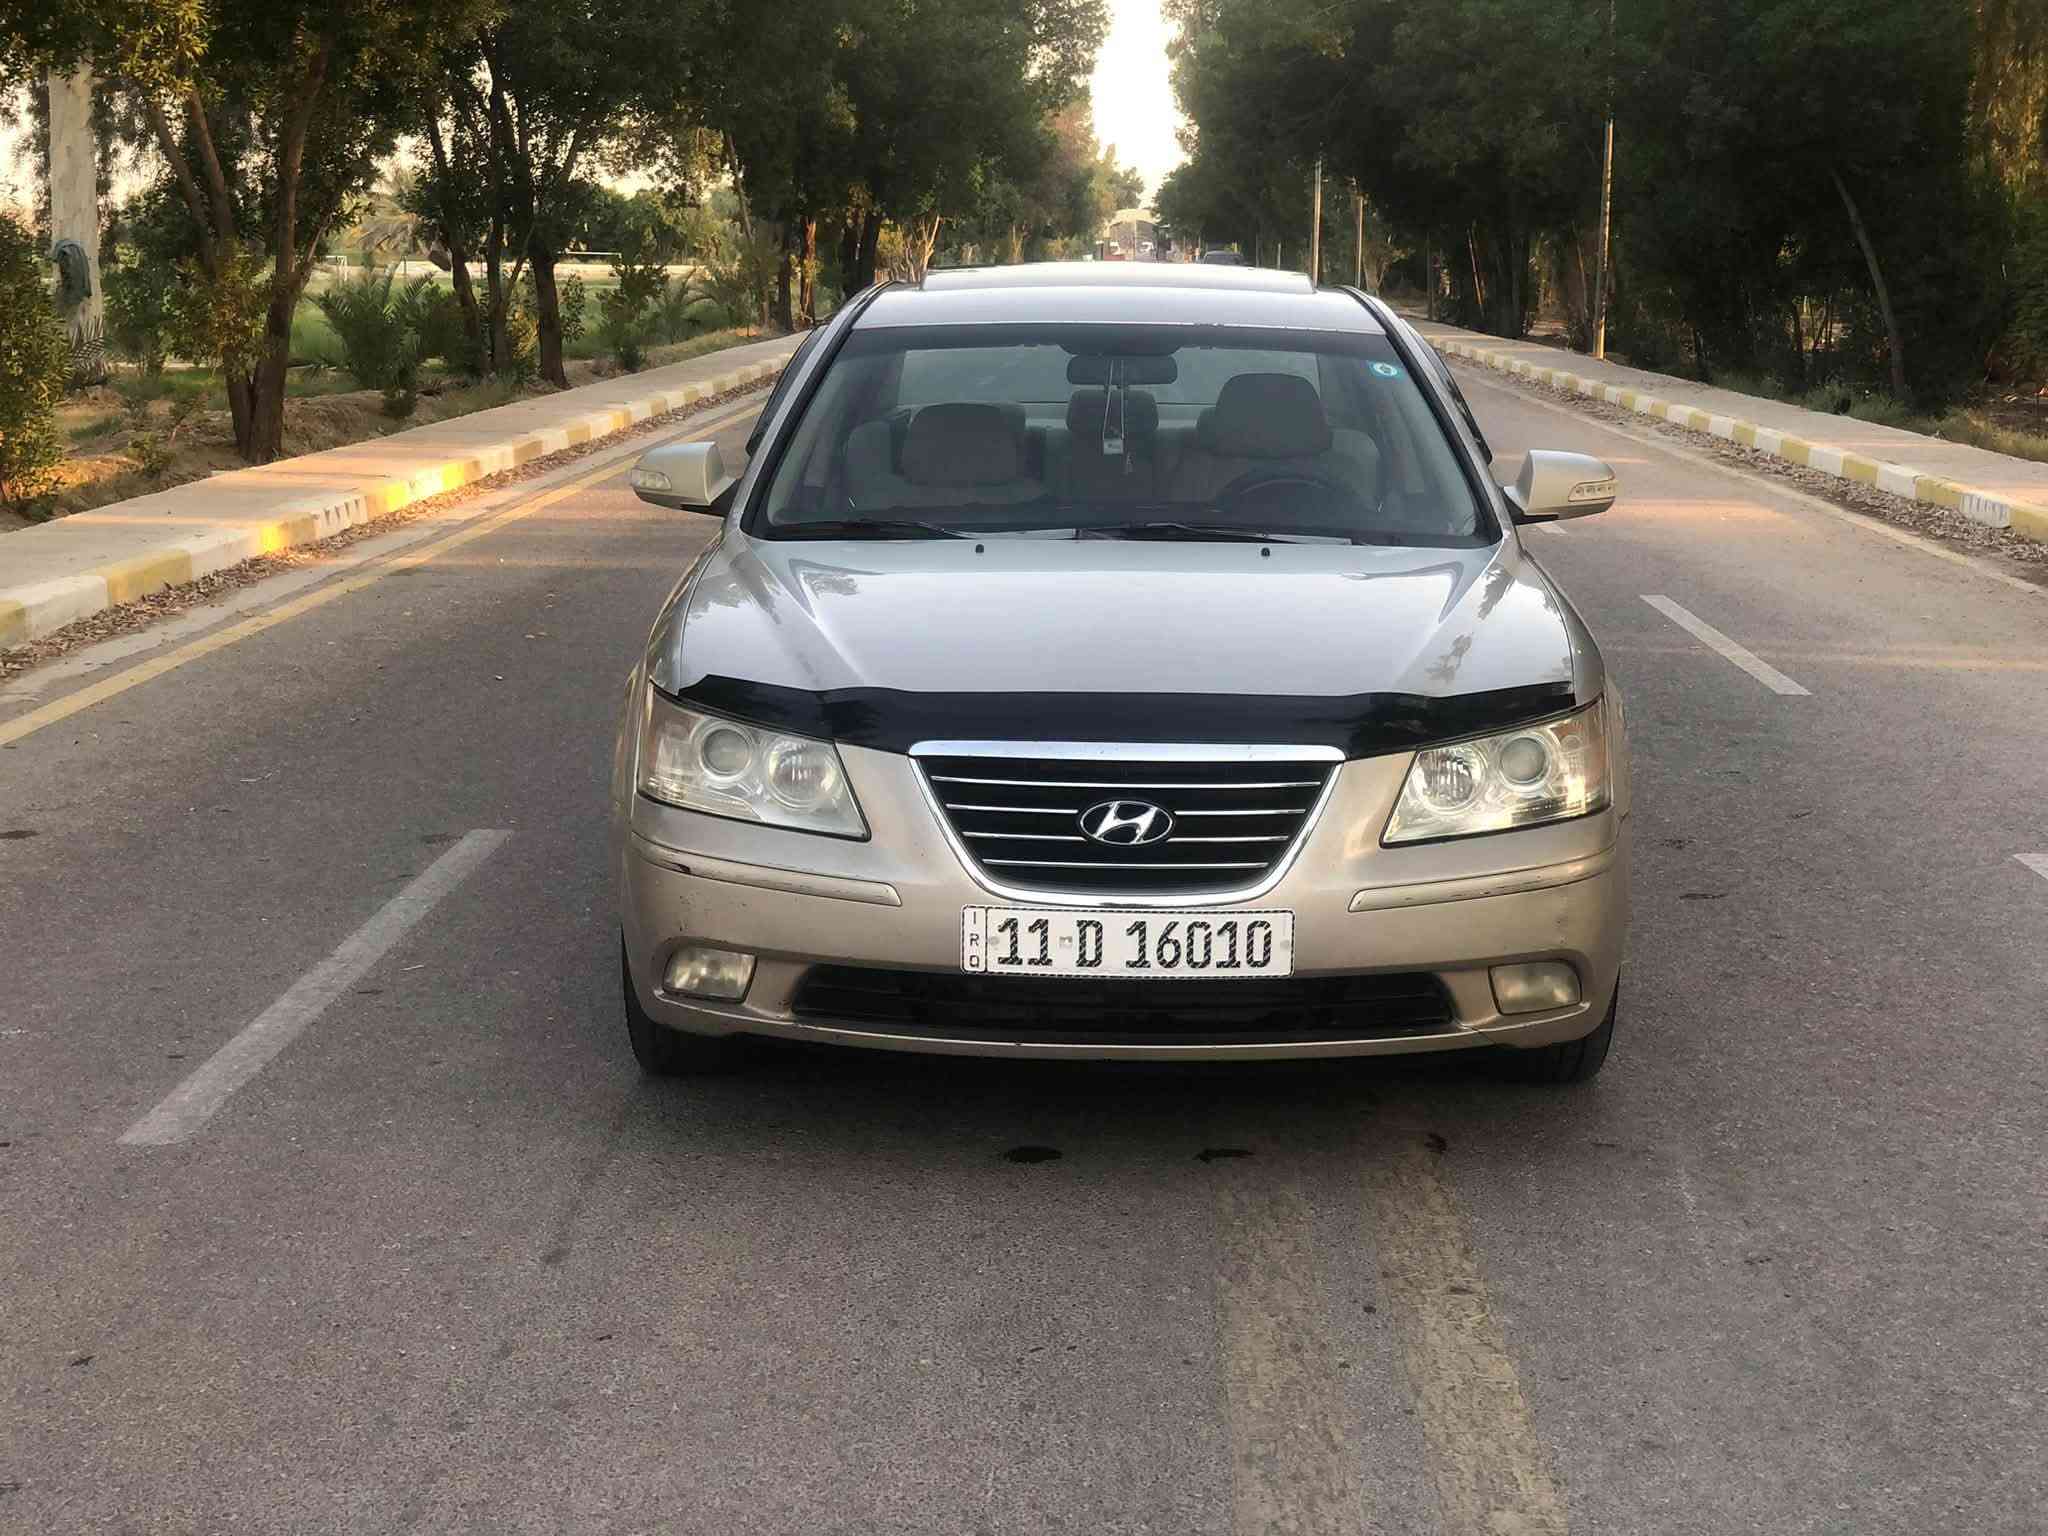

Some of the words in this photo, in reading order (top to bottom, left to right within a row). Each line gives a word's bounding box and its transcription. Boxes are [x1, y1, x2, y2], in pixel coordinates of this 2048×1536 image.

[998, 918, 1053, 966] 11
[1075, 919, 1103, 968] D
[1125, 920, 1272, 969] 16010
